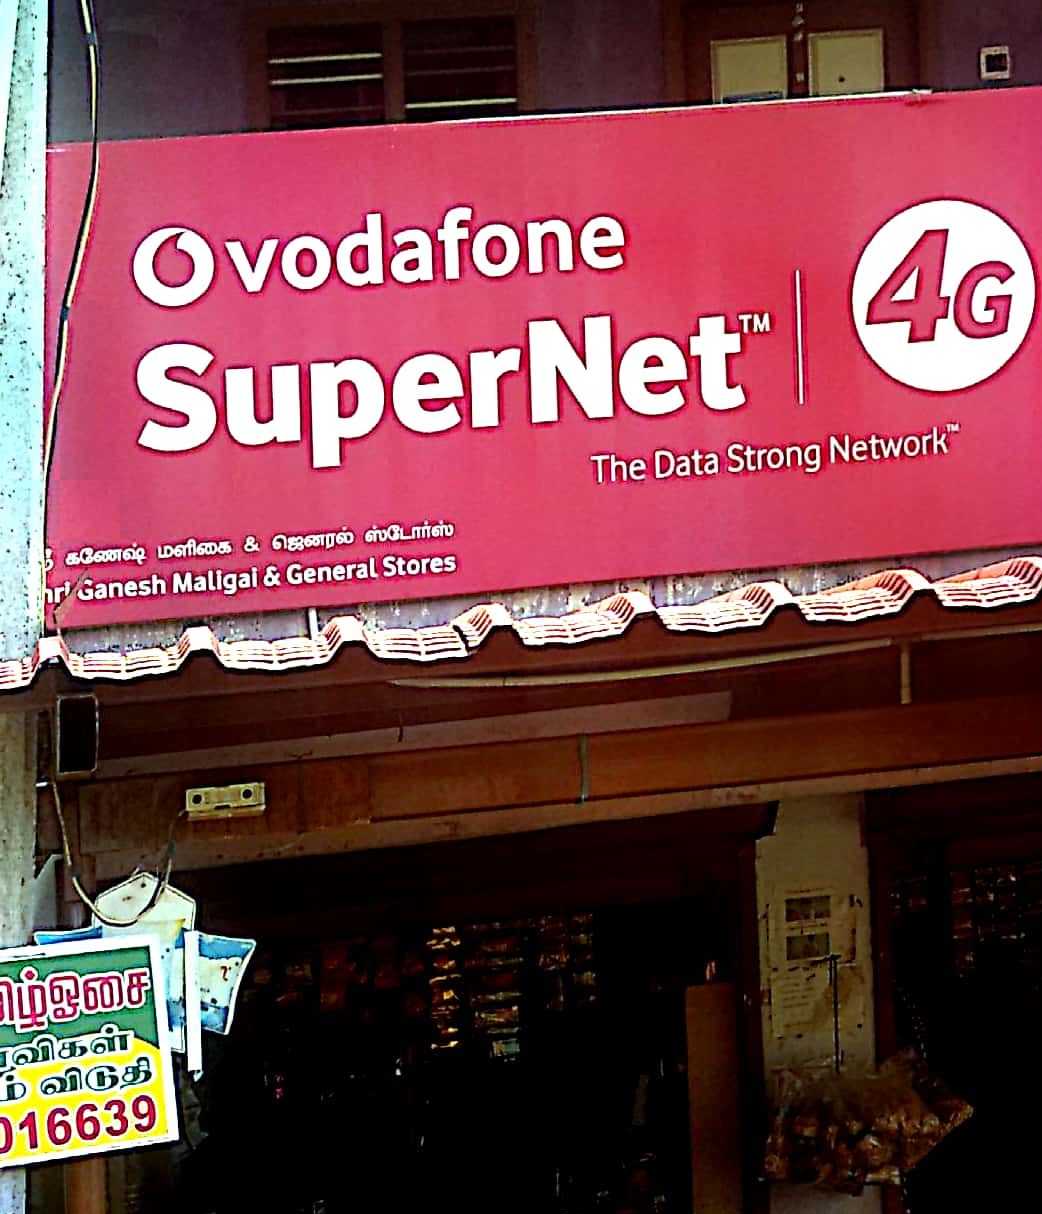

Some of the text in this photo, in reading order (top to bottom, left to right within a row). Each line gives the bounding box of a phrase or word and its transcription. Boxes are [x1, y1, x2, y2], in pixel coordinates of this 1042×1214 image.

[225, 206, 625, 293] vodafone
[865, 228, 1016, 344] 4G
[590, 453, 647, 484] The
[654, 446, 719, 479] Data
[726, 438, 821, 473] Strong
[244, 537, 260, 553] &
[77, 573, 167, 600] Ganesh
[172, 567, 258, 597] Maligai
[263, 567, 281, 587] &
[286, 559, 378, 585] General
[382, 553, 457, 576] Stores
[40, 1056, 153, 1096] விடுதி
